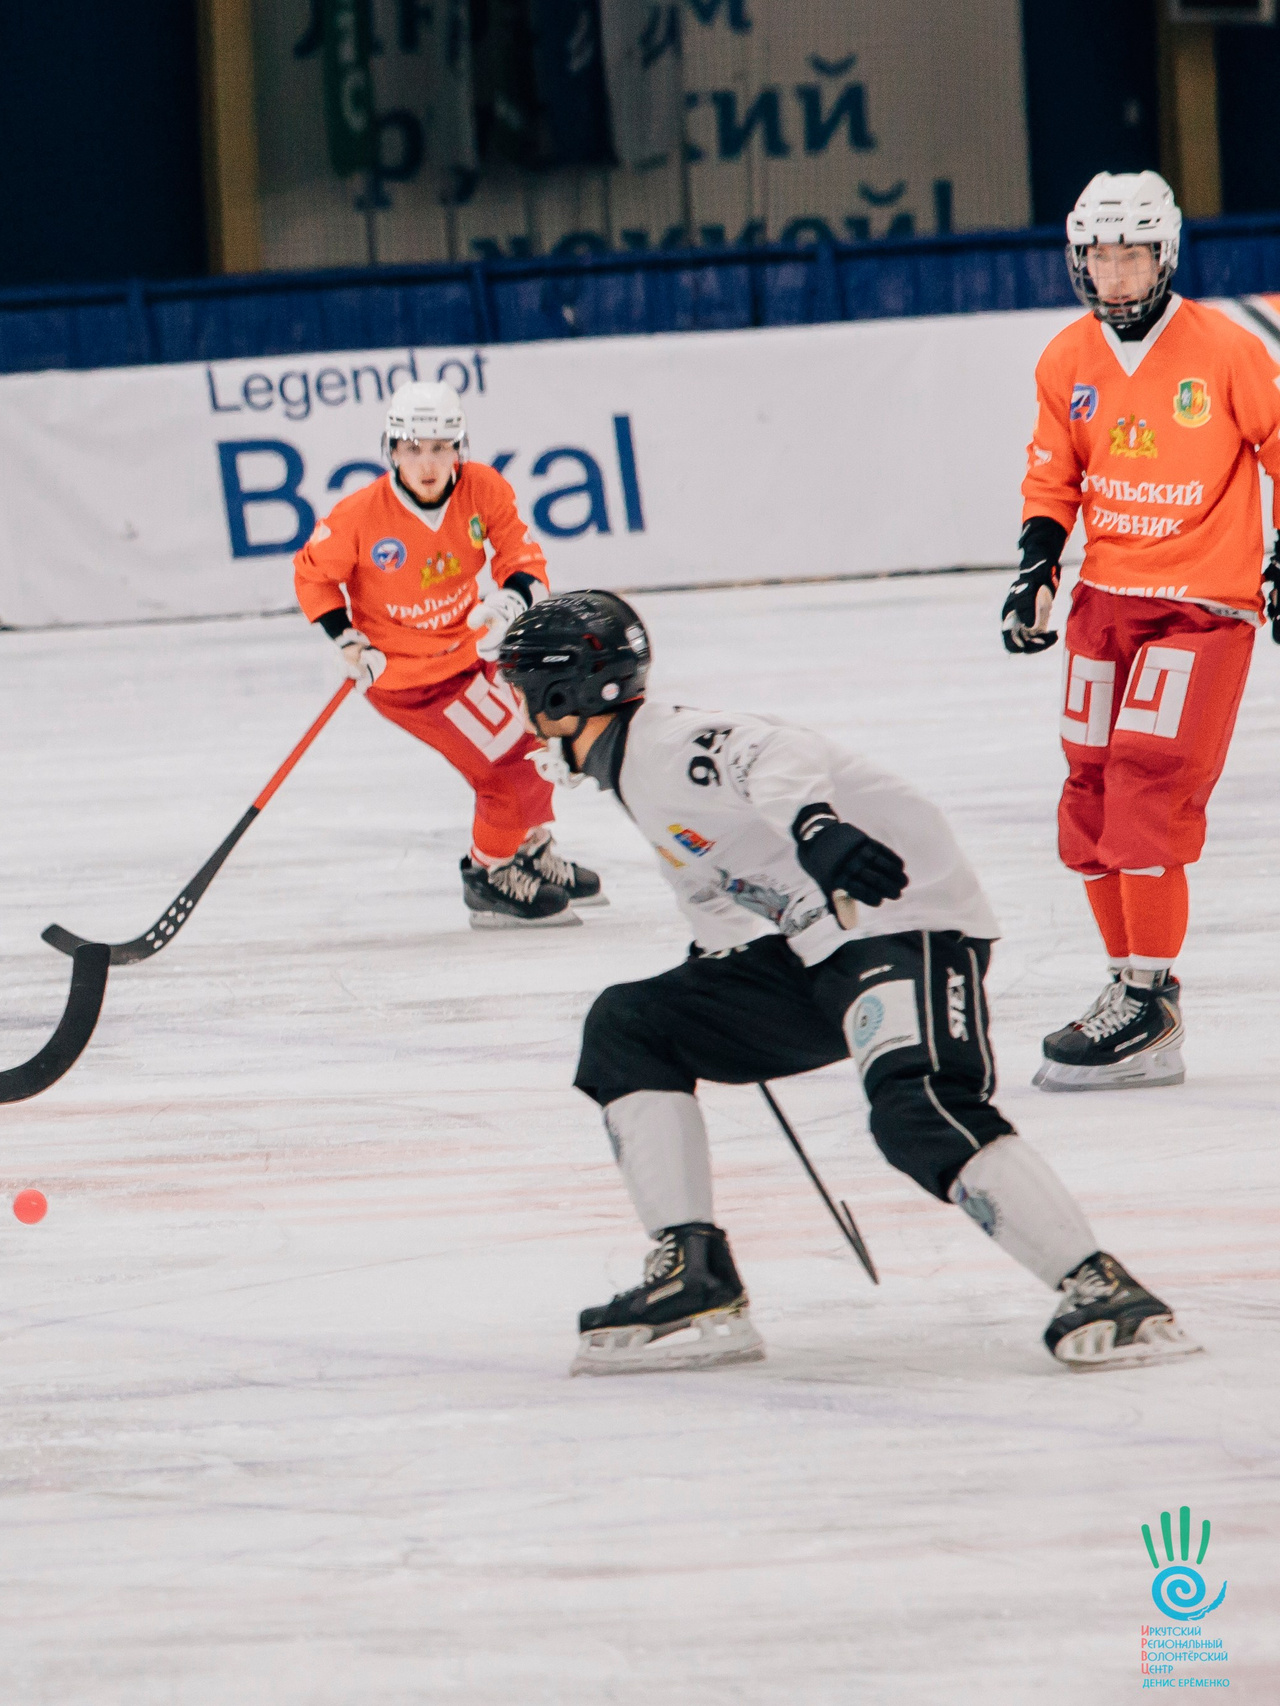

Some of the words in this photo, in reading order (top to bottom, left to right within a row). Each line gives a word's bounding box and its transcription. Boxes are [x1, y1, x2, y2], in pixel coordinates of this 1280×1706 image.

[205, 348, 420, 421] Legend
[215, 412, 648, 559] Bal
[1091, 505, 1184, 538] ТРУБНИК
